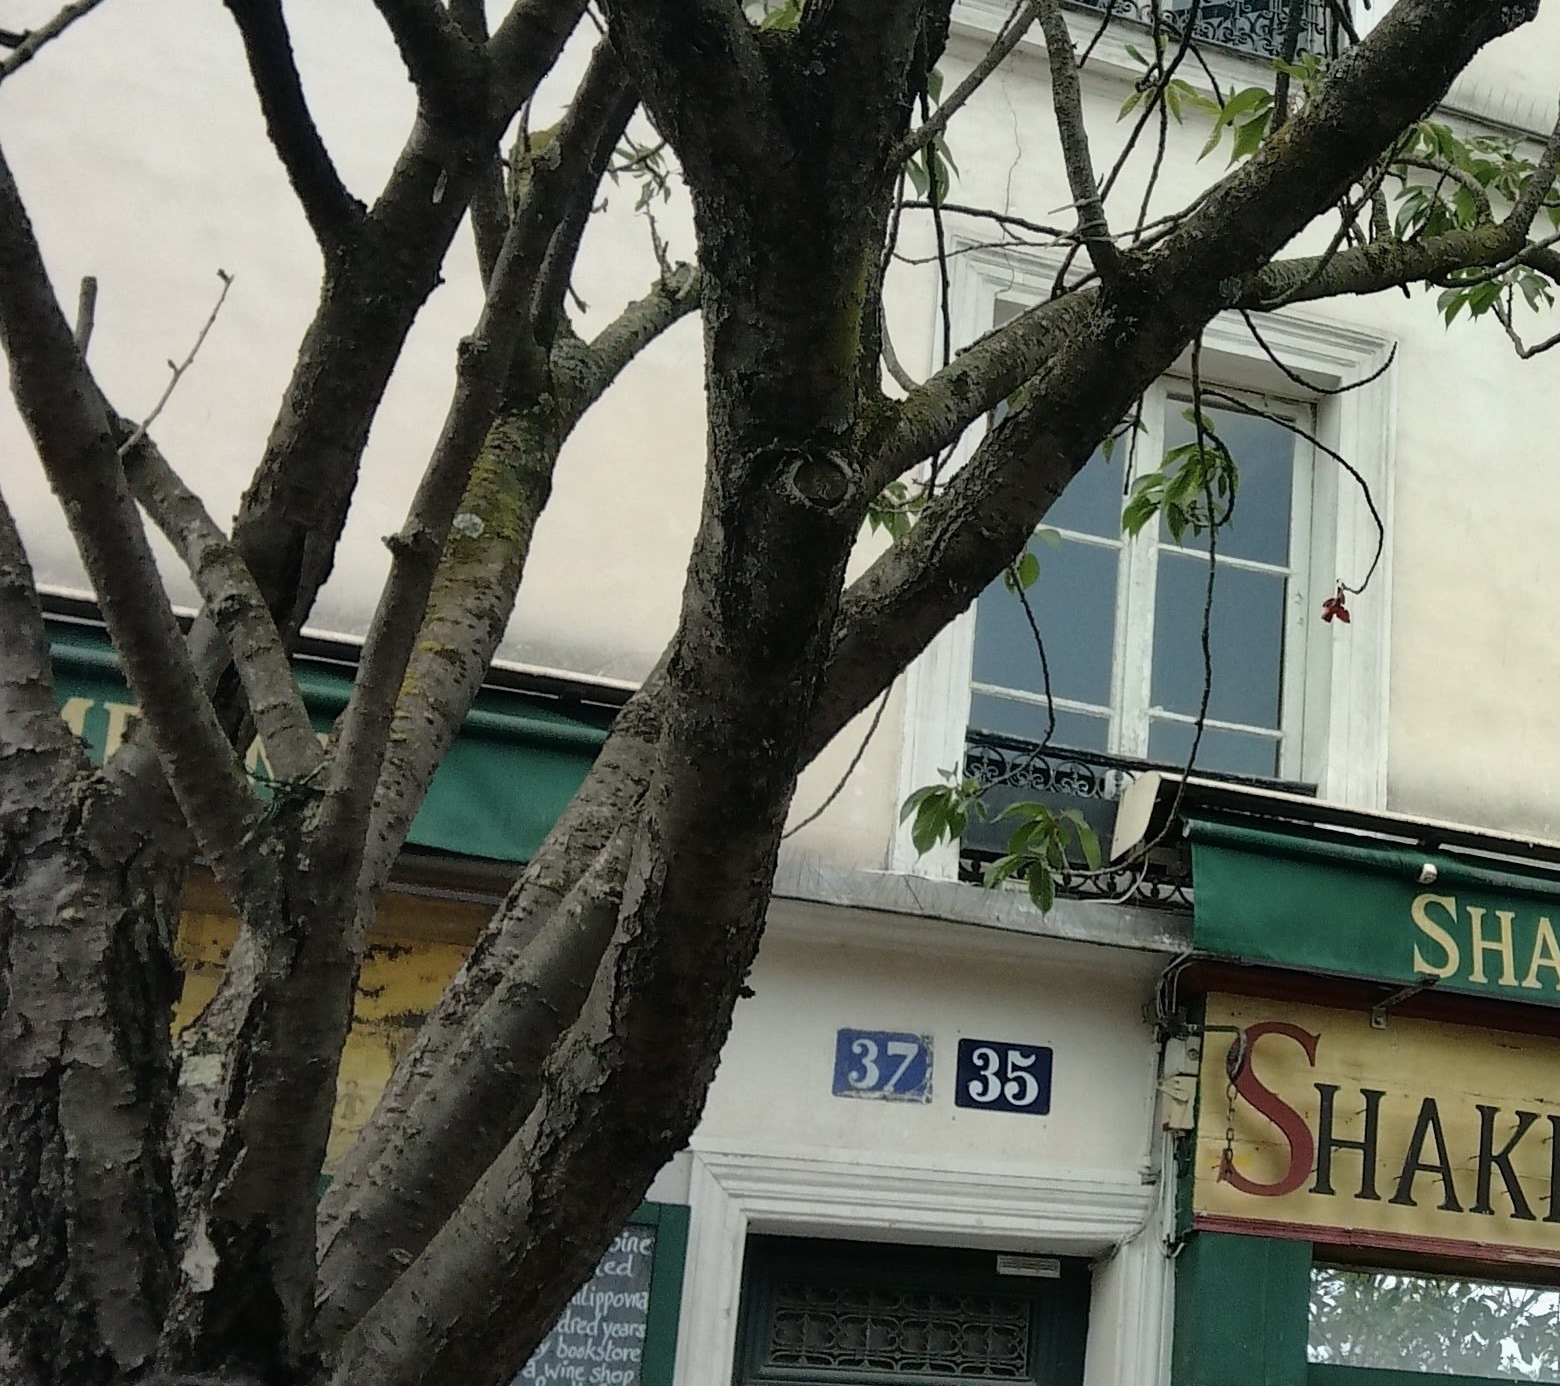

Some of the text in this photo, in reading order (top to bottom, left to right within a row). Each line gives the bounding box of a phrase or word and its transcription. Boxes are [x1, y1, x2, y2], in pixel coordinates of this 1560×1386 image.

[848, 1037, 920, 1093] 37
[967, 1046, 1040, 1107] 35
[602, 1320, 647, 1348] years
[556, 1335, 643, 1362] bookstore
[544, 1360, 586, 1381] wine
